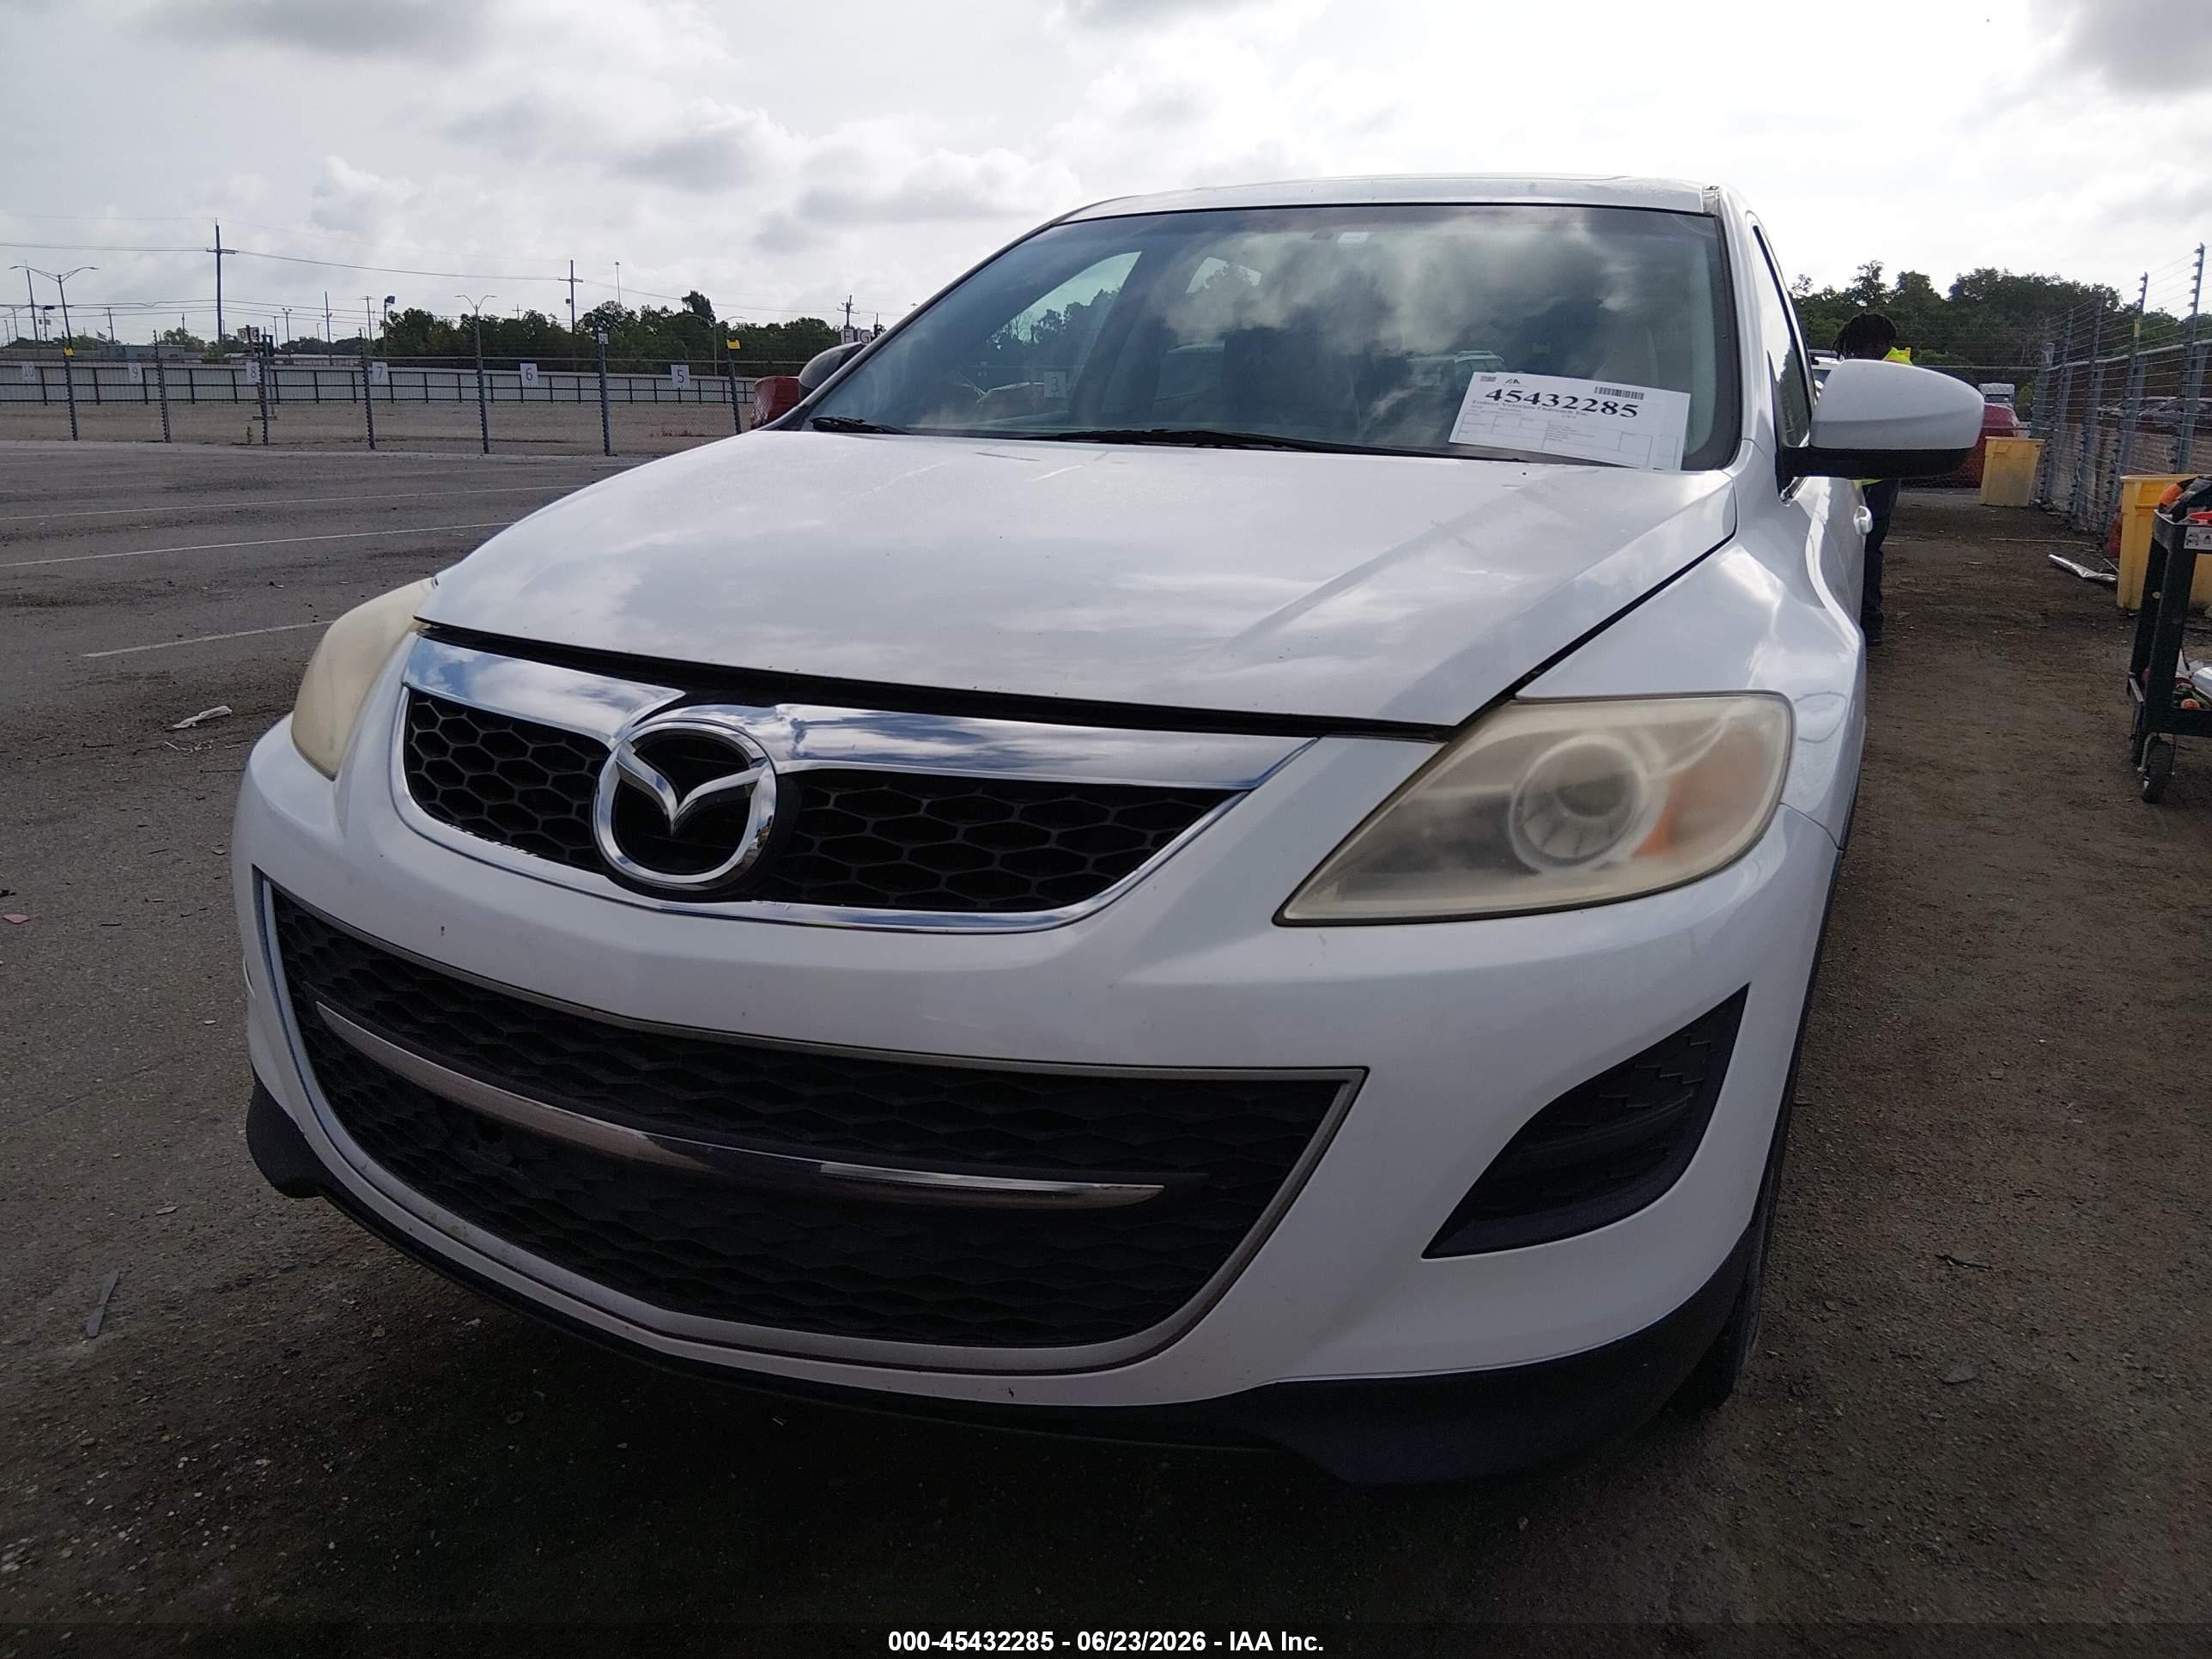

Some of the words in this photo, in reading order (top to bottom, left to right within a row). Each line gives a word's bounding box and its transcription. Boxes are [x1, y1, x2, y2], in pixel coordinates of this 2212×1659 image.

[860, 330, 870, 344] G
[23, 365, 34, 377] 10
[132, 367, 139, 379] 9
[250, 366, 256, 379] 8
[377, 366, 384, 379] 7
[526, 368, 533, 381] 6
[677, 369, 684, 383] 5
[1050, 376, 1059, 392] 3
[1485, 388, 1638, 418] 45432285
